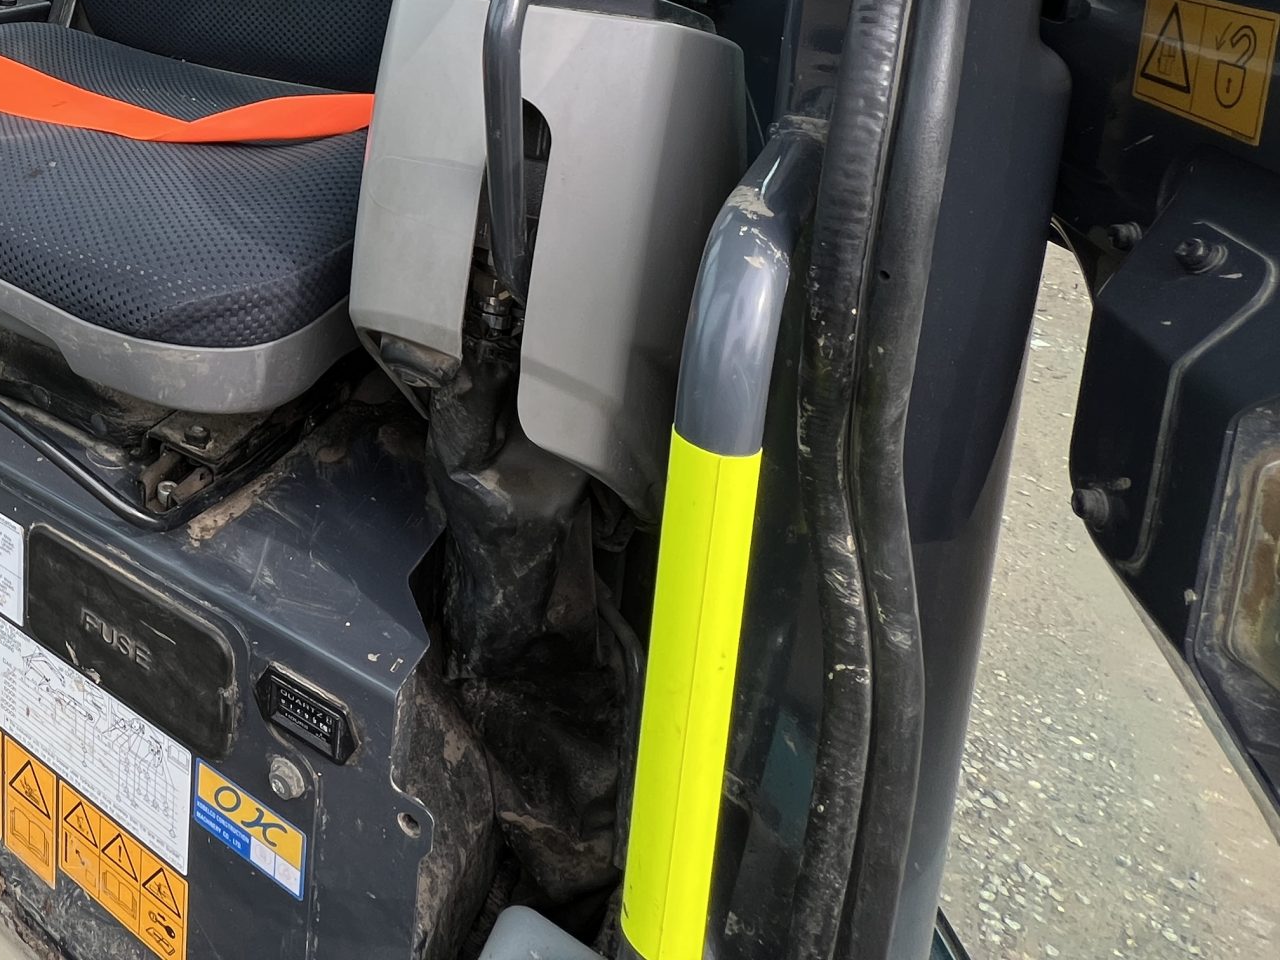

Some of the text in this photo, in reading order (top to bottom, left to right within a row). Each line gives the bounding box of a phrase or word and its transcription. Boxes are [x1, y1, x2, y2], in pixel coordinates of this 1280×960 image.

[81, 607, 152, 670] FUSE
[280, 688, 323, 719] QUARTZ
[216, 813, 249, 844] CONSTRUCTION
